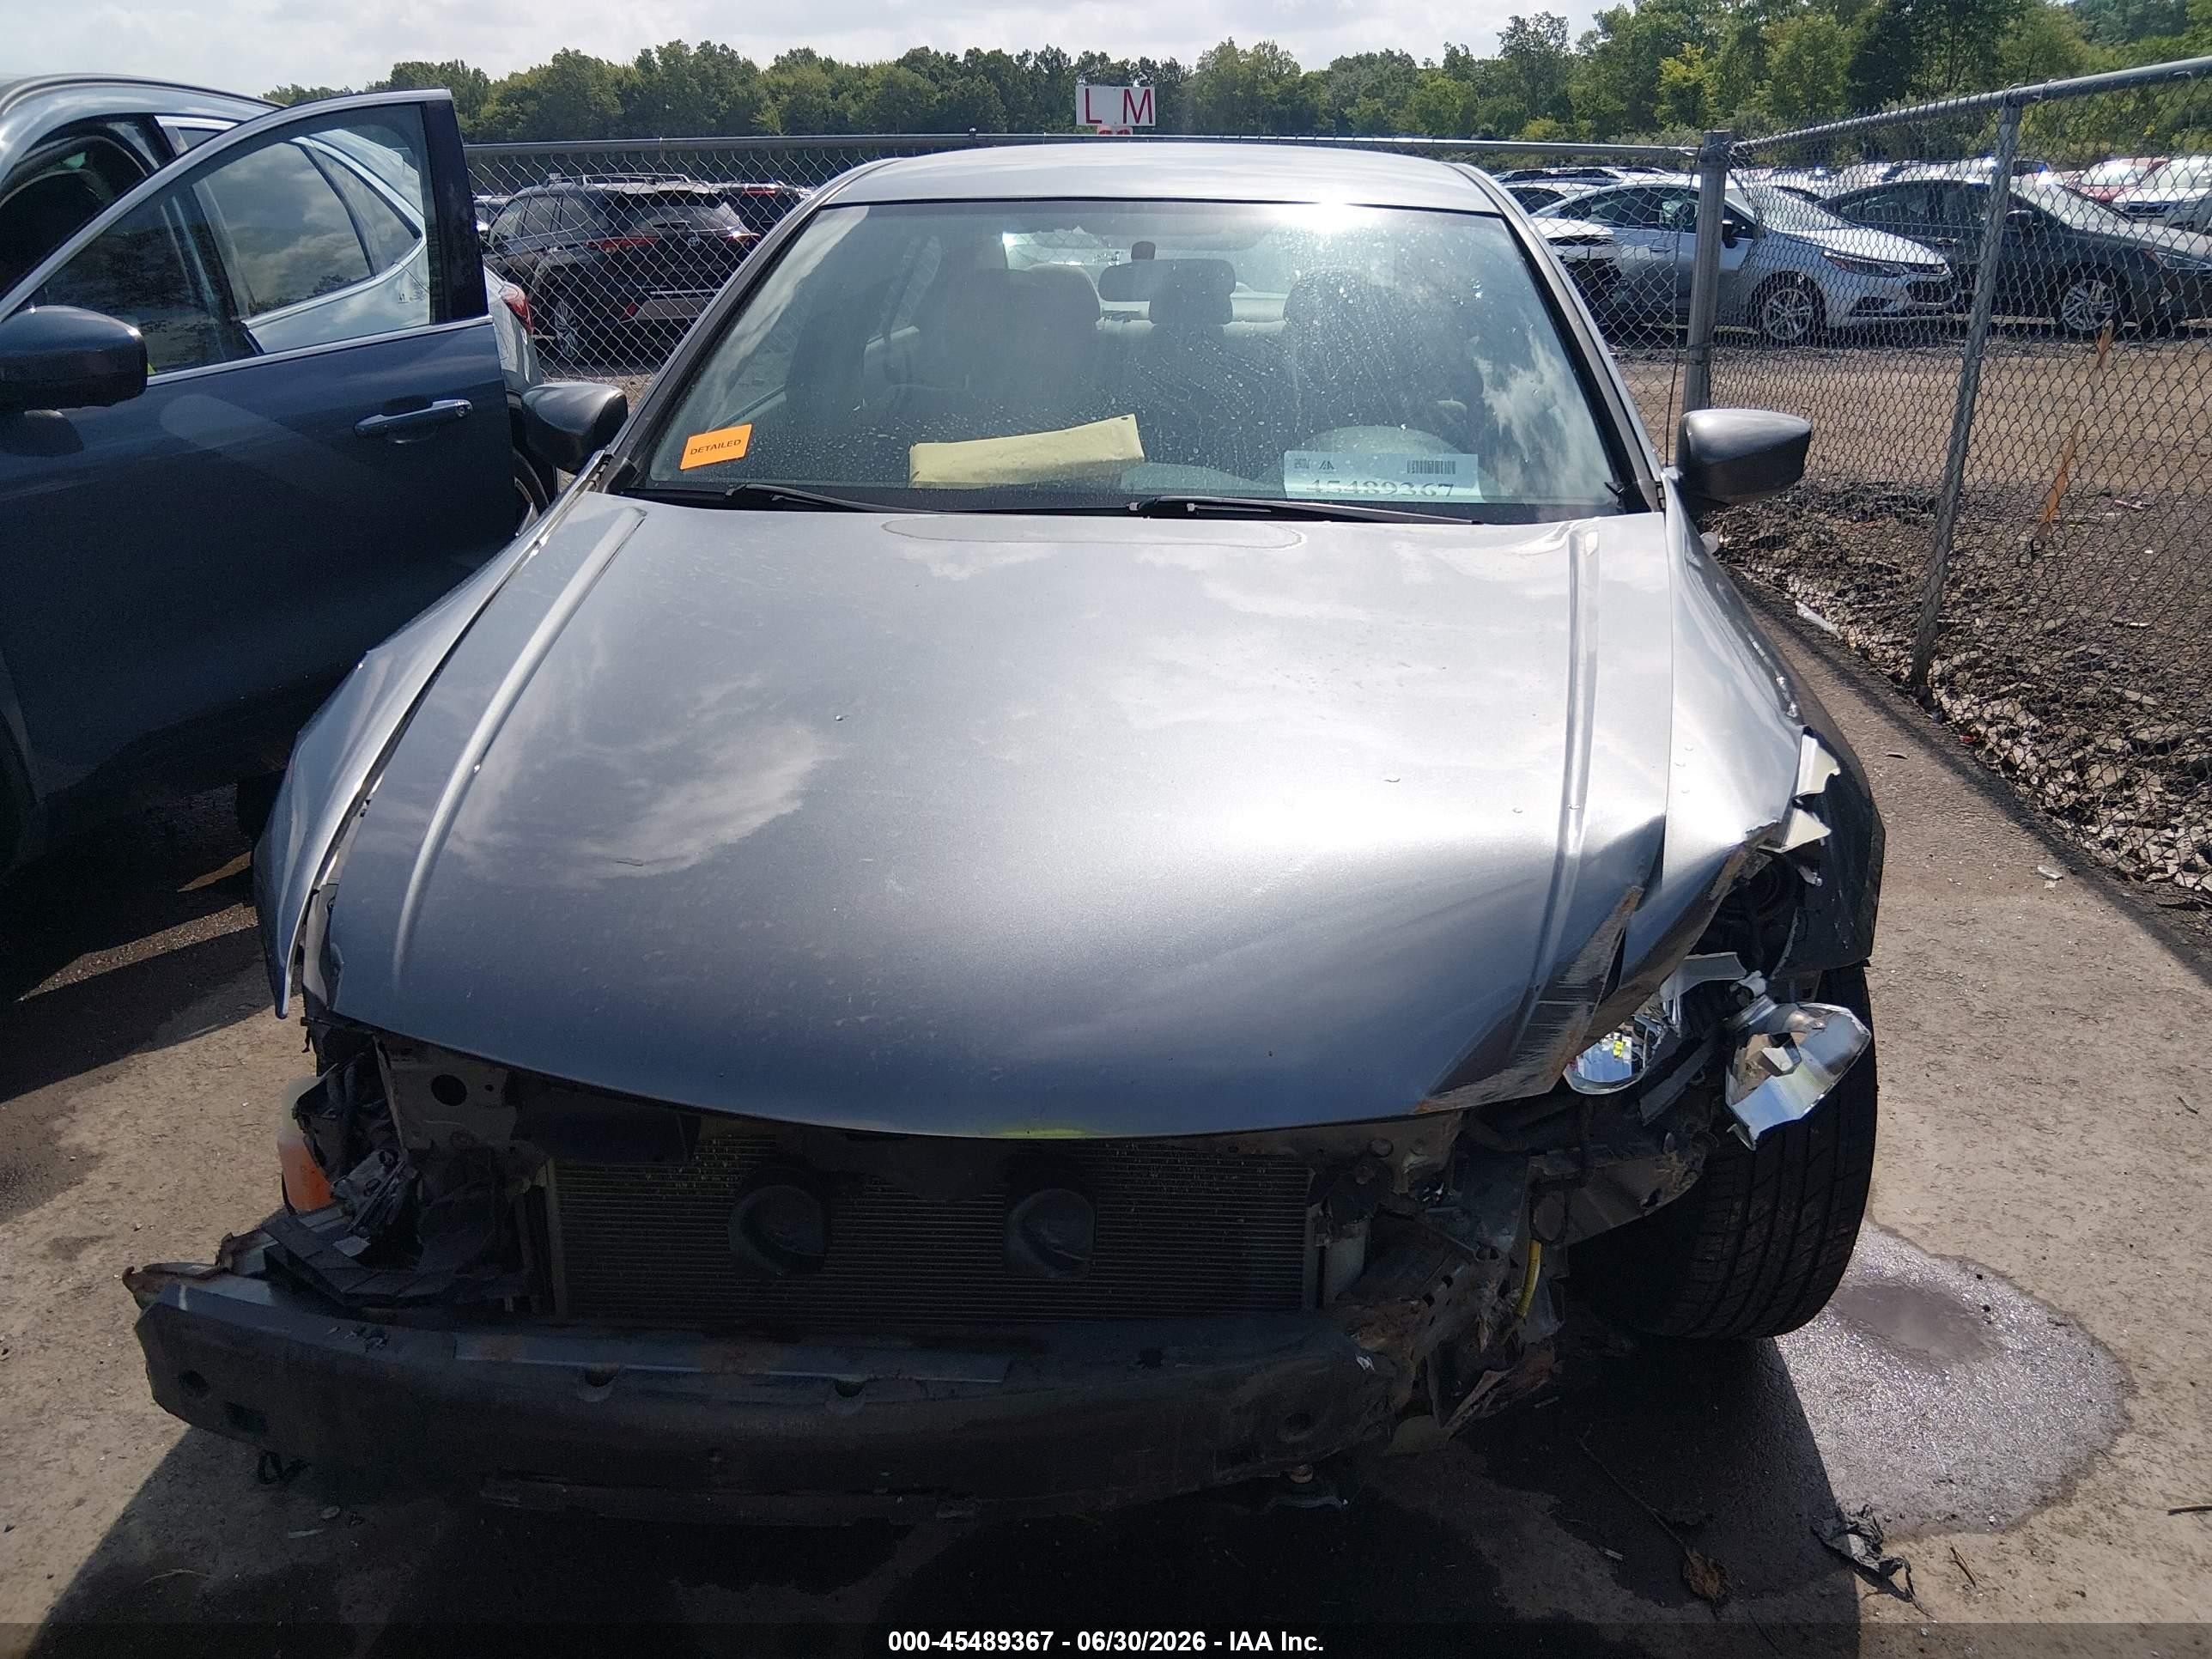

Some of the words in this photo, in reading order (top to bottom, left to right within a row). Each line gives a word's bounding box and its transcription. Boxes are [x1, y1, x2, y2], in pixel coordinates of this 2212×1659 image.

[1085, 88, 1103, 124] L
[1122, 88, 1153, 124] M
[690, 439, 742, 455] DETAILED
[1307, 478, 1455, 498] 45489367
